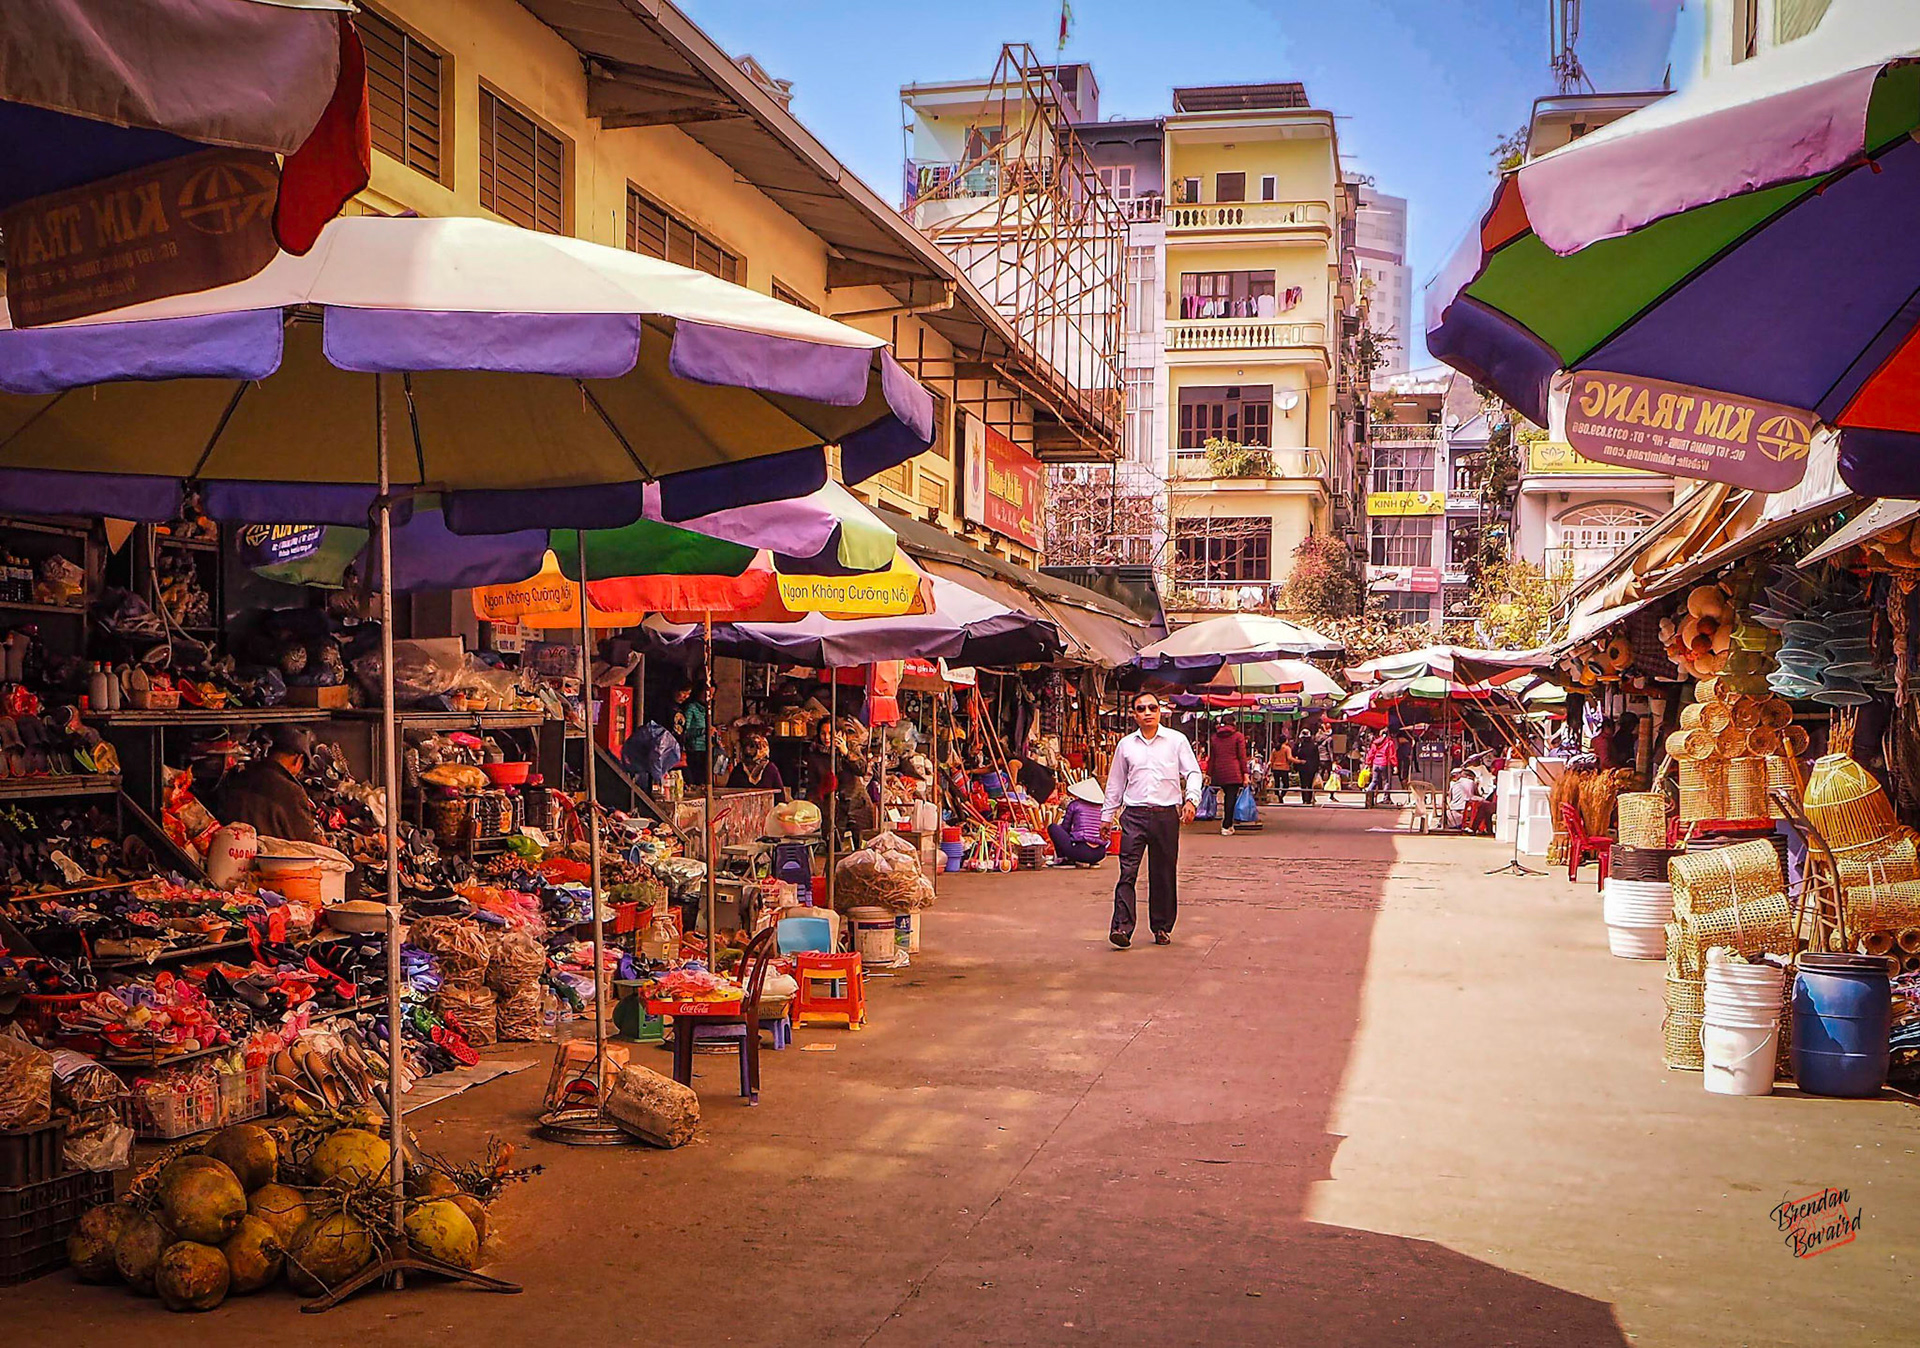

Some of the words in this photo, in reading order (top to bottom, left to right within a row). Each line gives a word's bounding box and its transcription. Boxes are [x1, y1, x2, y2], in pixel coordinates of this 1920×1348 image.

[1374, 500, 1398, 509] KINH
[484, 594, 504, 610] Ngon
[505, 590, 531, 606] Không
[782, 583, 809, 602] Ngon
[811, 584, 845, 602] Không
[848, 585, 889, 604] Cưỡng
[891, 586, 910, 603] Nổi
